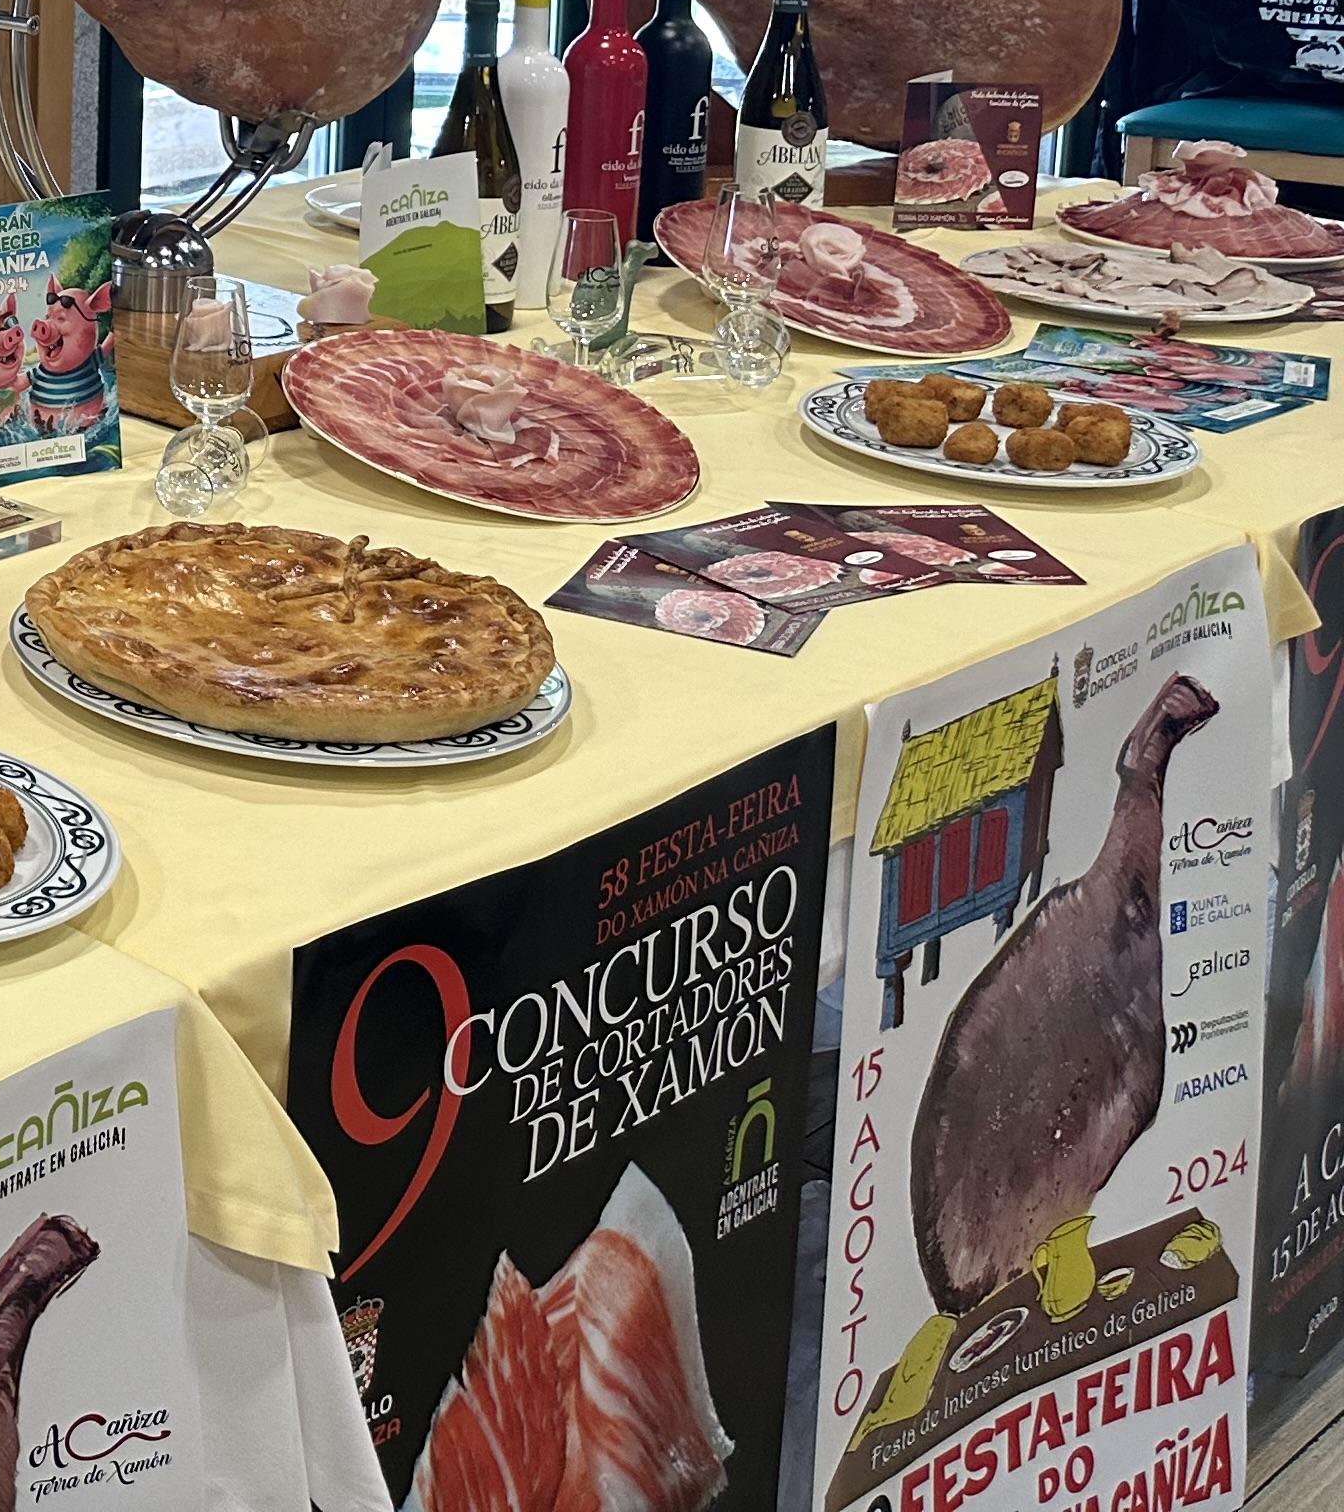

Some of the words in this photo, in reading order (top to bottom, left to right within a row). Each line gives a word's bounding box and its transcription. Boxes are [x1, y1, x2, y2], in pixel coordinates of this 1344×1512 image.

[596, 915, 626, 946] DO
[630, 877, 698, 930] XAMÓN
[705, 862, 729, 889] NA
[734, 823, 800, 875] CAÑIZA
[598, 858, 629, 911] 58
[638, 774, 802, 891] FESTA-FEIRA
[444, 865, 798, 1097] CONCURSO
[510, 1056, 567, 1124] DE
[573, 936, 793, 1089] CORTADORES
[331, 944, 471, 1283] 9
[523, 1087, 600, 1184] DE
[611, 983, 791, 1138] XAMÓN
[850, 1047, 885, 1101] 15
[50, 1151, 66, 1173] EN
[1166, 1139, 1249, 1205] 2024
[1038, 1444, 1095, 1503] DO
